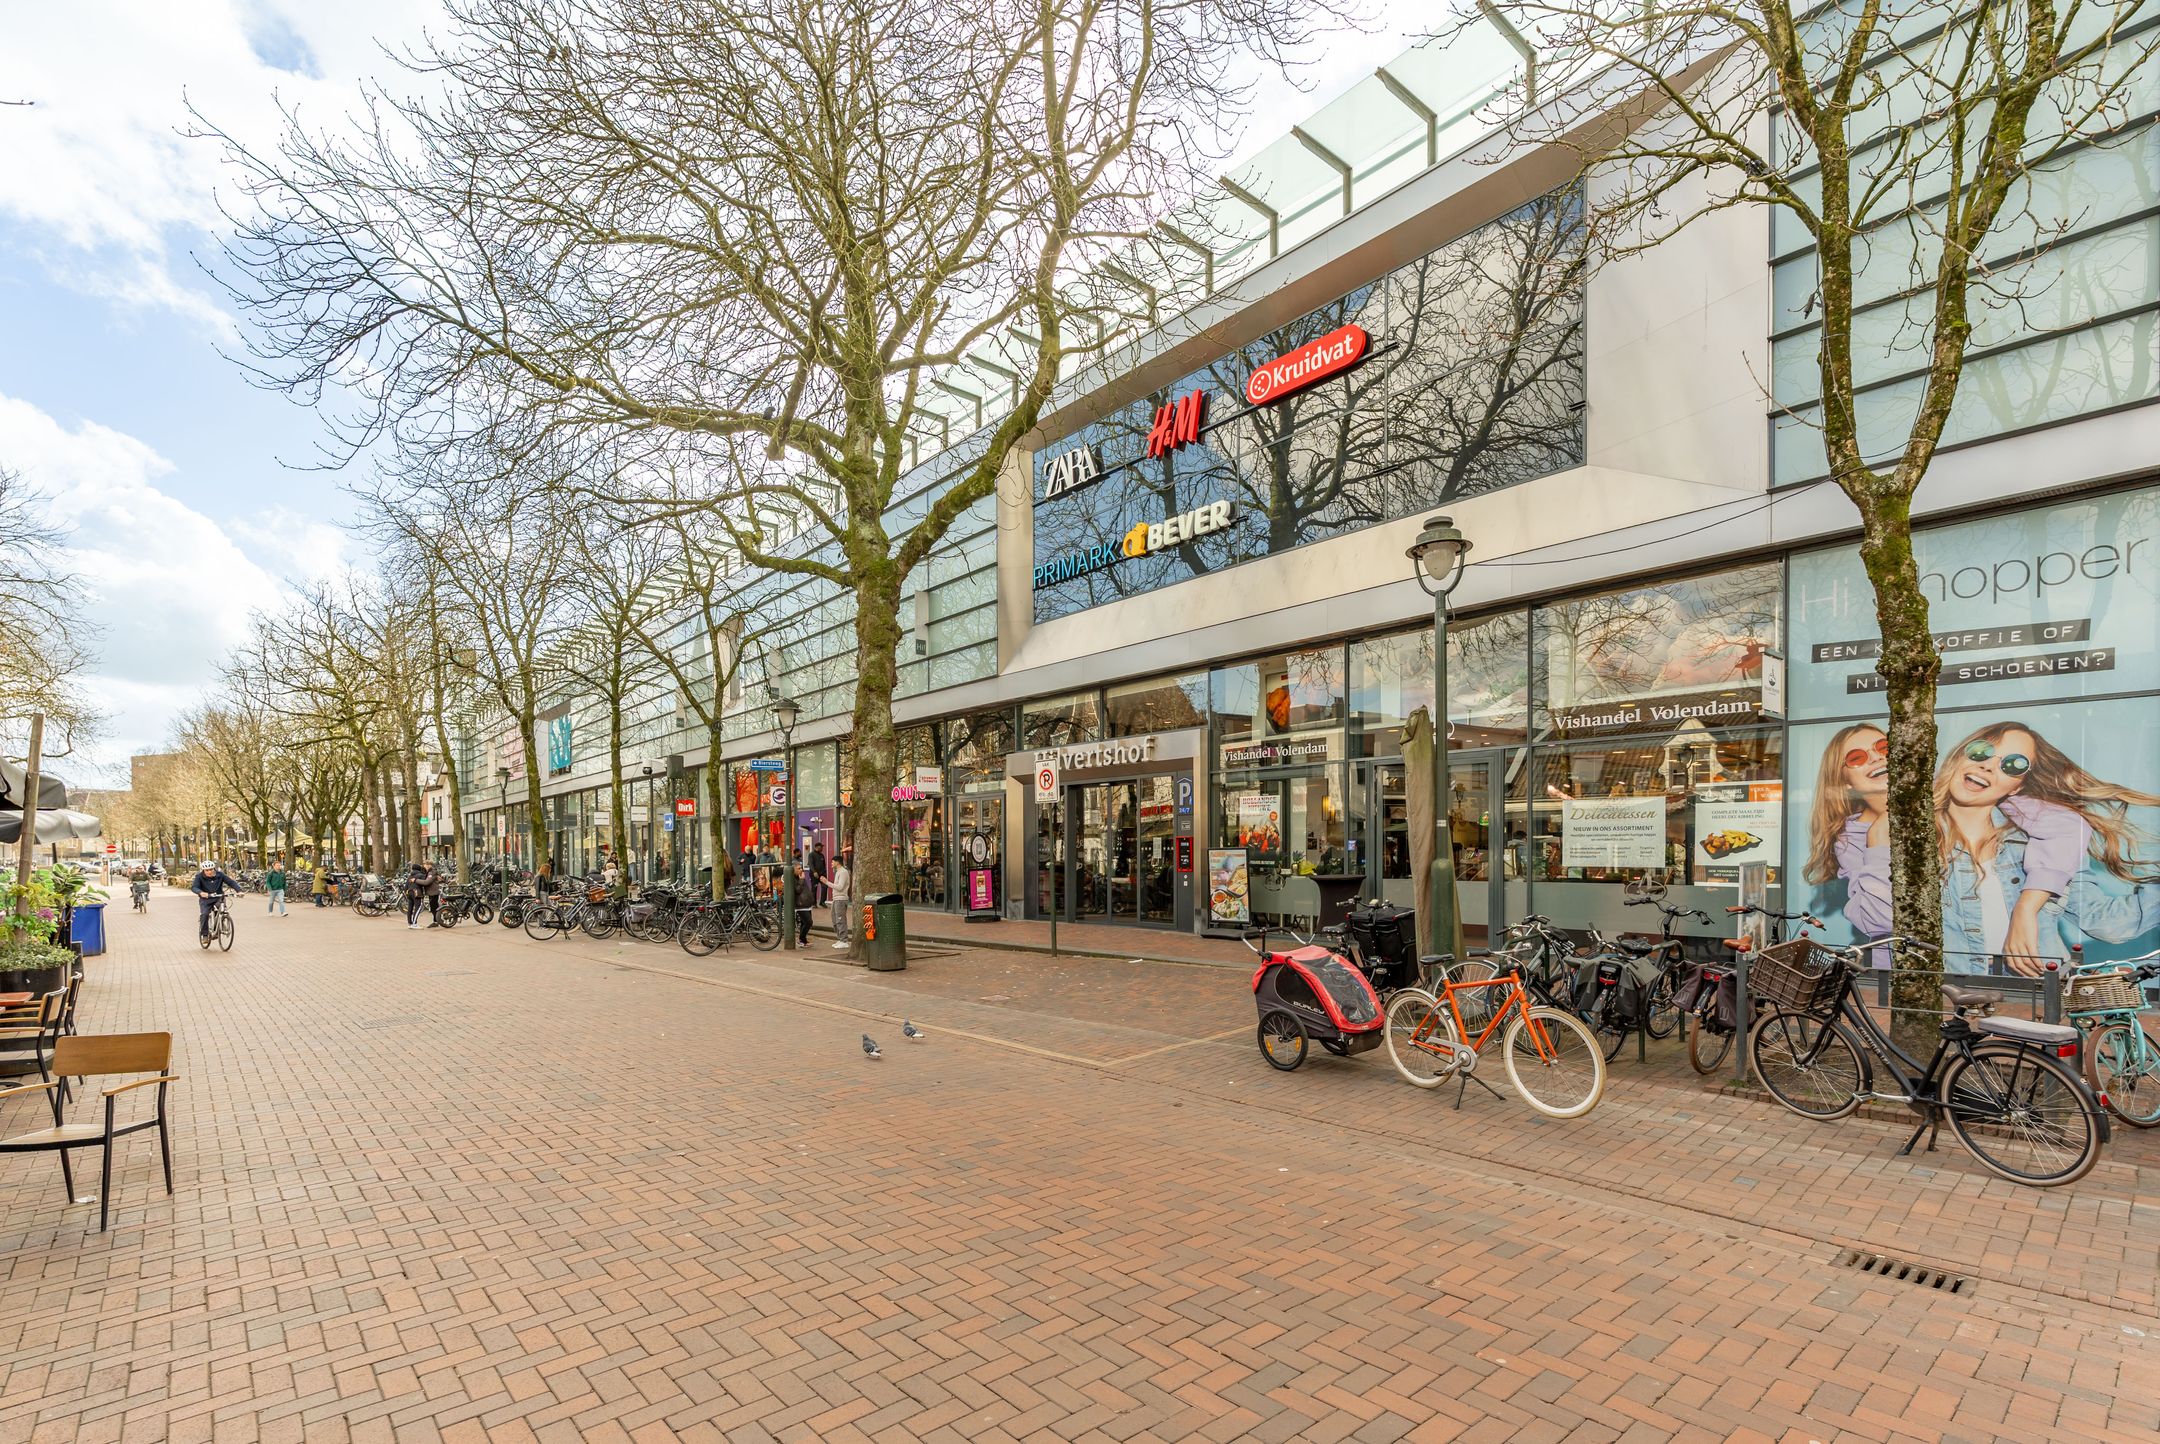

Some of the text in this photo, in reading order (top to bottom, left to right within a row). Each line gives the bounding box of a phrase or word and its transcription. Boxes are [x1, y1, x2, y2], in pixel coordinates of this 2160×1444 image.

[1272, 334, 1354, 389] Kruidvat
[1147, 389, 1204, 459] H&M
[1044, 446, 1101, 499] ZARA
[1147, 501, 1231, 552] BEVER
[1033, 540, 1118, 588] PRIMARK
[1801, 538, 2149, 623] Hi hopper
[1820, 645, 1858, 659] EEN
[1932, 630, 2022, 649] KOFFIE
[2043, 625, 2075, 639] OF
[1958, 652, 2106, 679] SCHOENEN?
[1555, 699, 1751, 730] Vishandel Volendam
[1034, 735, 1155, 771] lvertshof
[1223, 742, 1329, 762] Vishandel Volendam
[677, 803, 693, 812] Dirk
[1570, 807, 1657, 820] Delicatessen
